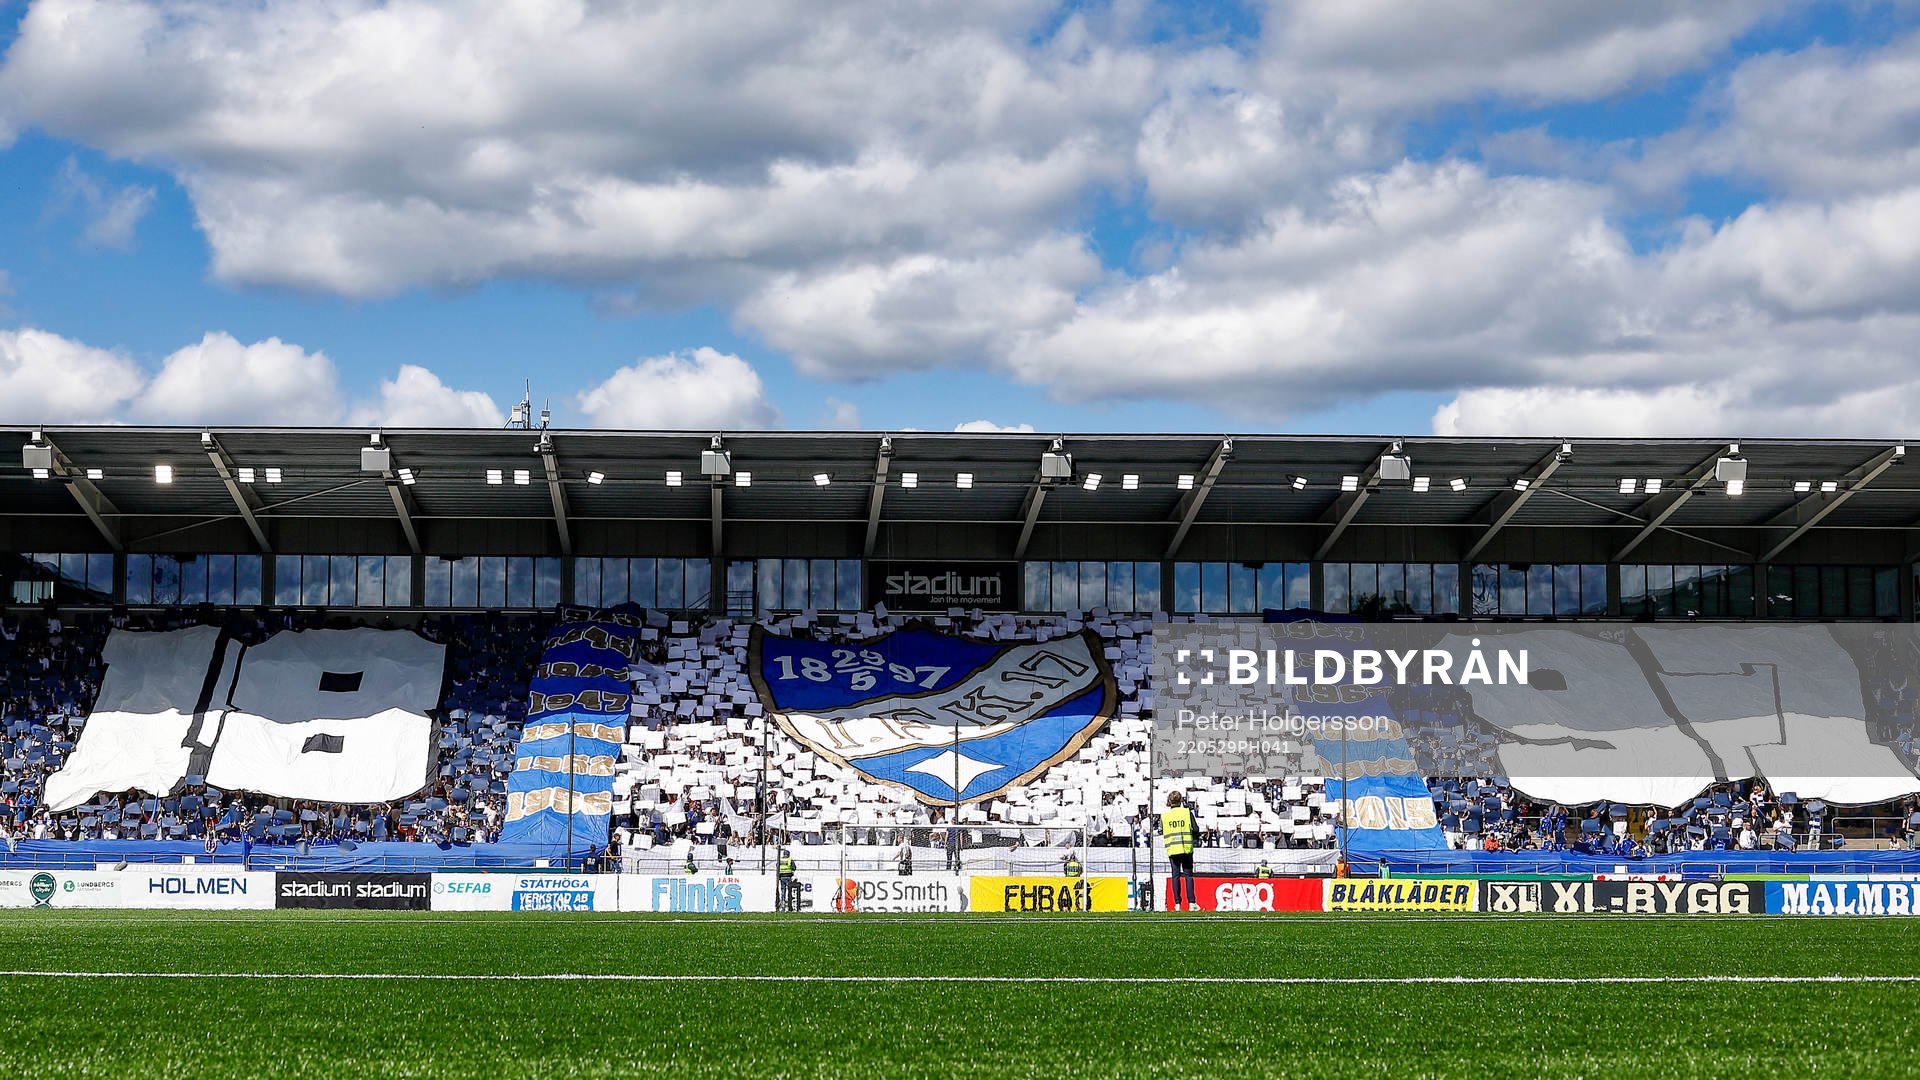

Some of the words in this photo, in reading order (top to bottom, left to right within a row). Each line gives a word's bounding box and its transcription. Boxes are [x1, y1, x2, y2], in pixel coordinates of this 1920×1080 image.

[885, 571, 1001, 595] stadium
[929, 595, 945, 604] Join
[946, 595, 959, 604] the
[960, 595, 1001, 604] movement
[773, 655, 832, 683] 18
[888, 662, 952, 690] 97
[850, 670, 877, 692] 5
[528, 689, 631, 716] 1947
[1168, 819, 1186, 829] FOTO
[148, 877, 248, 895] HOLMEN
[280, 880, 351, 898] stadium
[356, 881, 427, 898] stadium
[447, 882, 492, 894] SEFAB
[651, 878, 743, 913] Flinks
[863, 881, 888, 901] DS
[893, 880, 948, 901] Smith
[1331, 879, 1470, 905] BLÅKLÄDER
[519, 892, 573, 904] VERKSTAD
[573, 892, 589, 903] AB
[1491, 884, 1538, 912] XL
[1550, 881, 1751, 914] XL-BYGG
